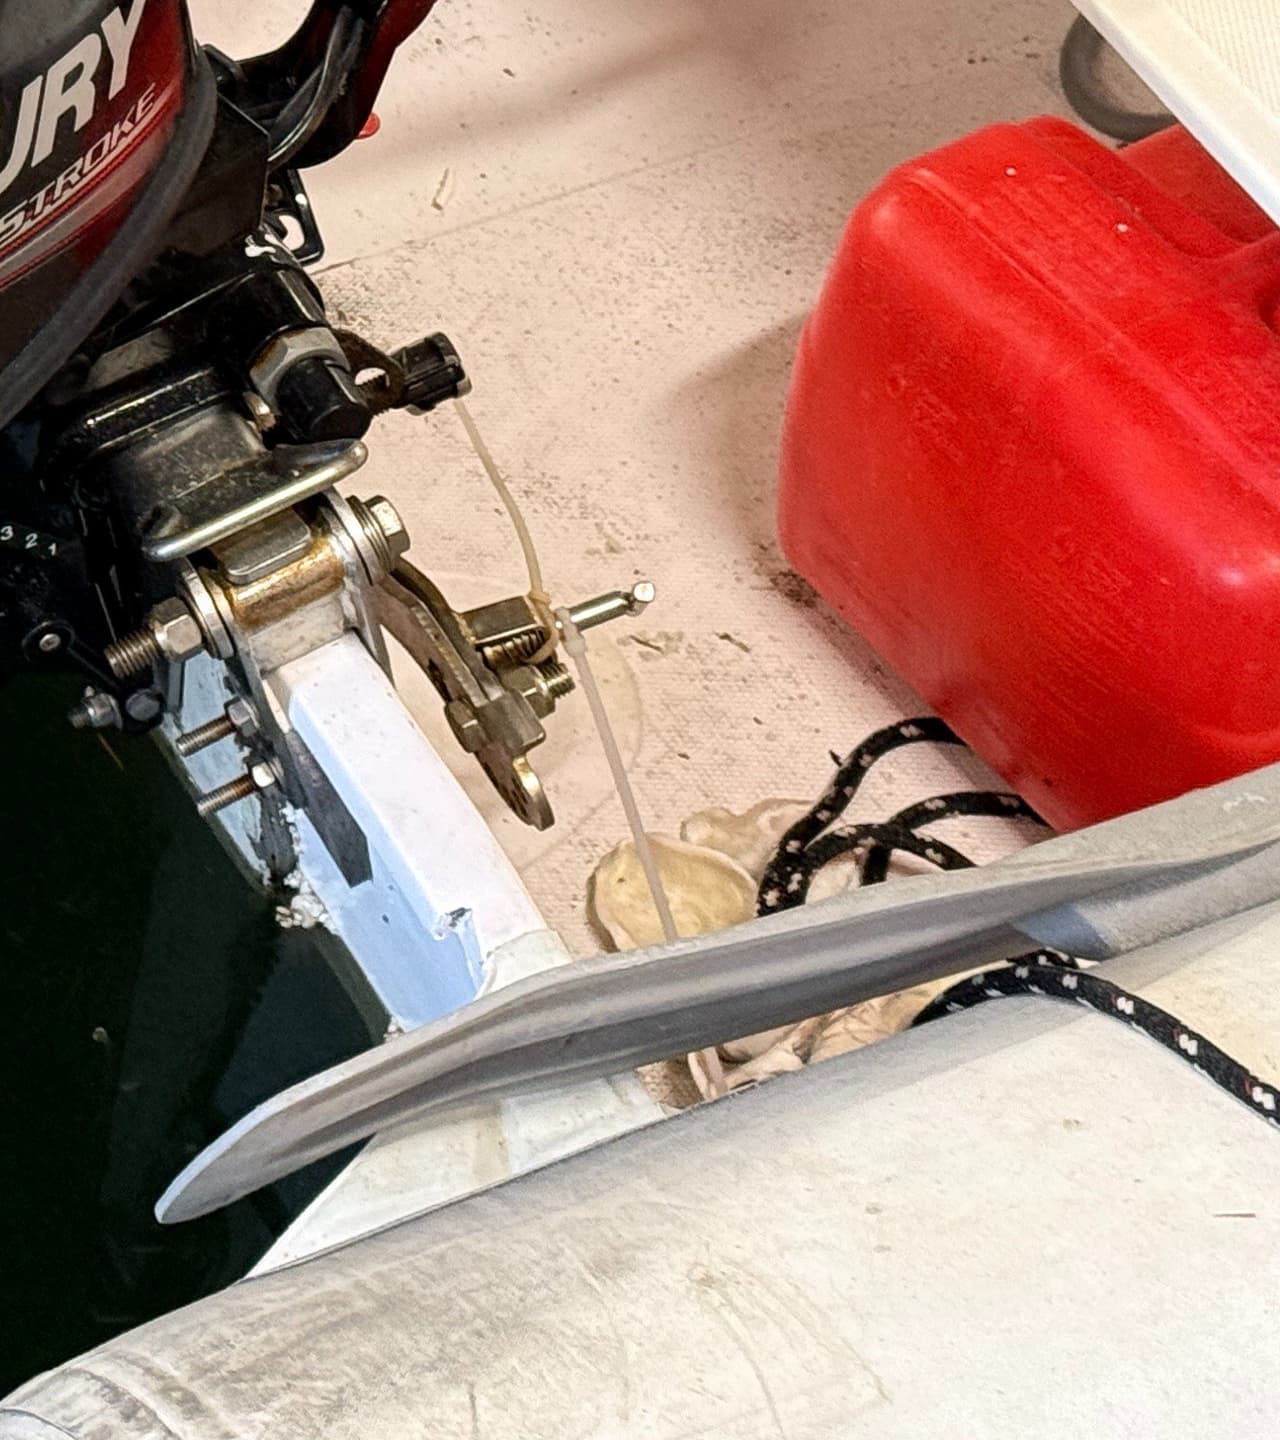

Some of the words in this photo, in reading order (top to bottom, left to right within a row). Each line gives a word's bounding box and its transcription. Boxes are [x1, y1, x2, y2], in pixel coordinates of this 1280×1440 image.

[0, 525, 14, 541] 3
[25, 532, 38, 549] 2
[48, 542, 57, 556] 1
